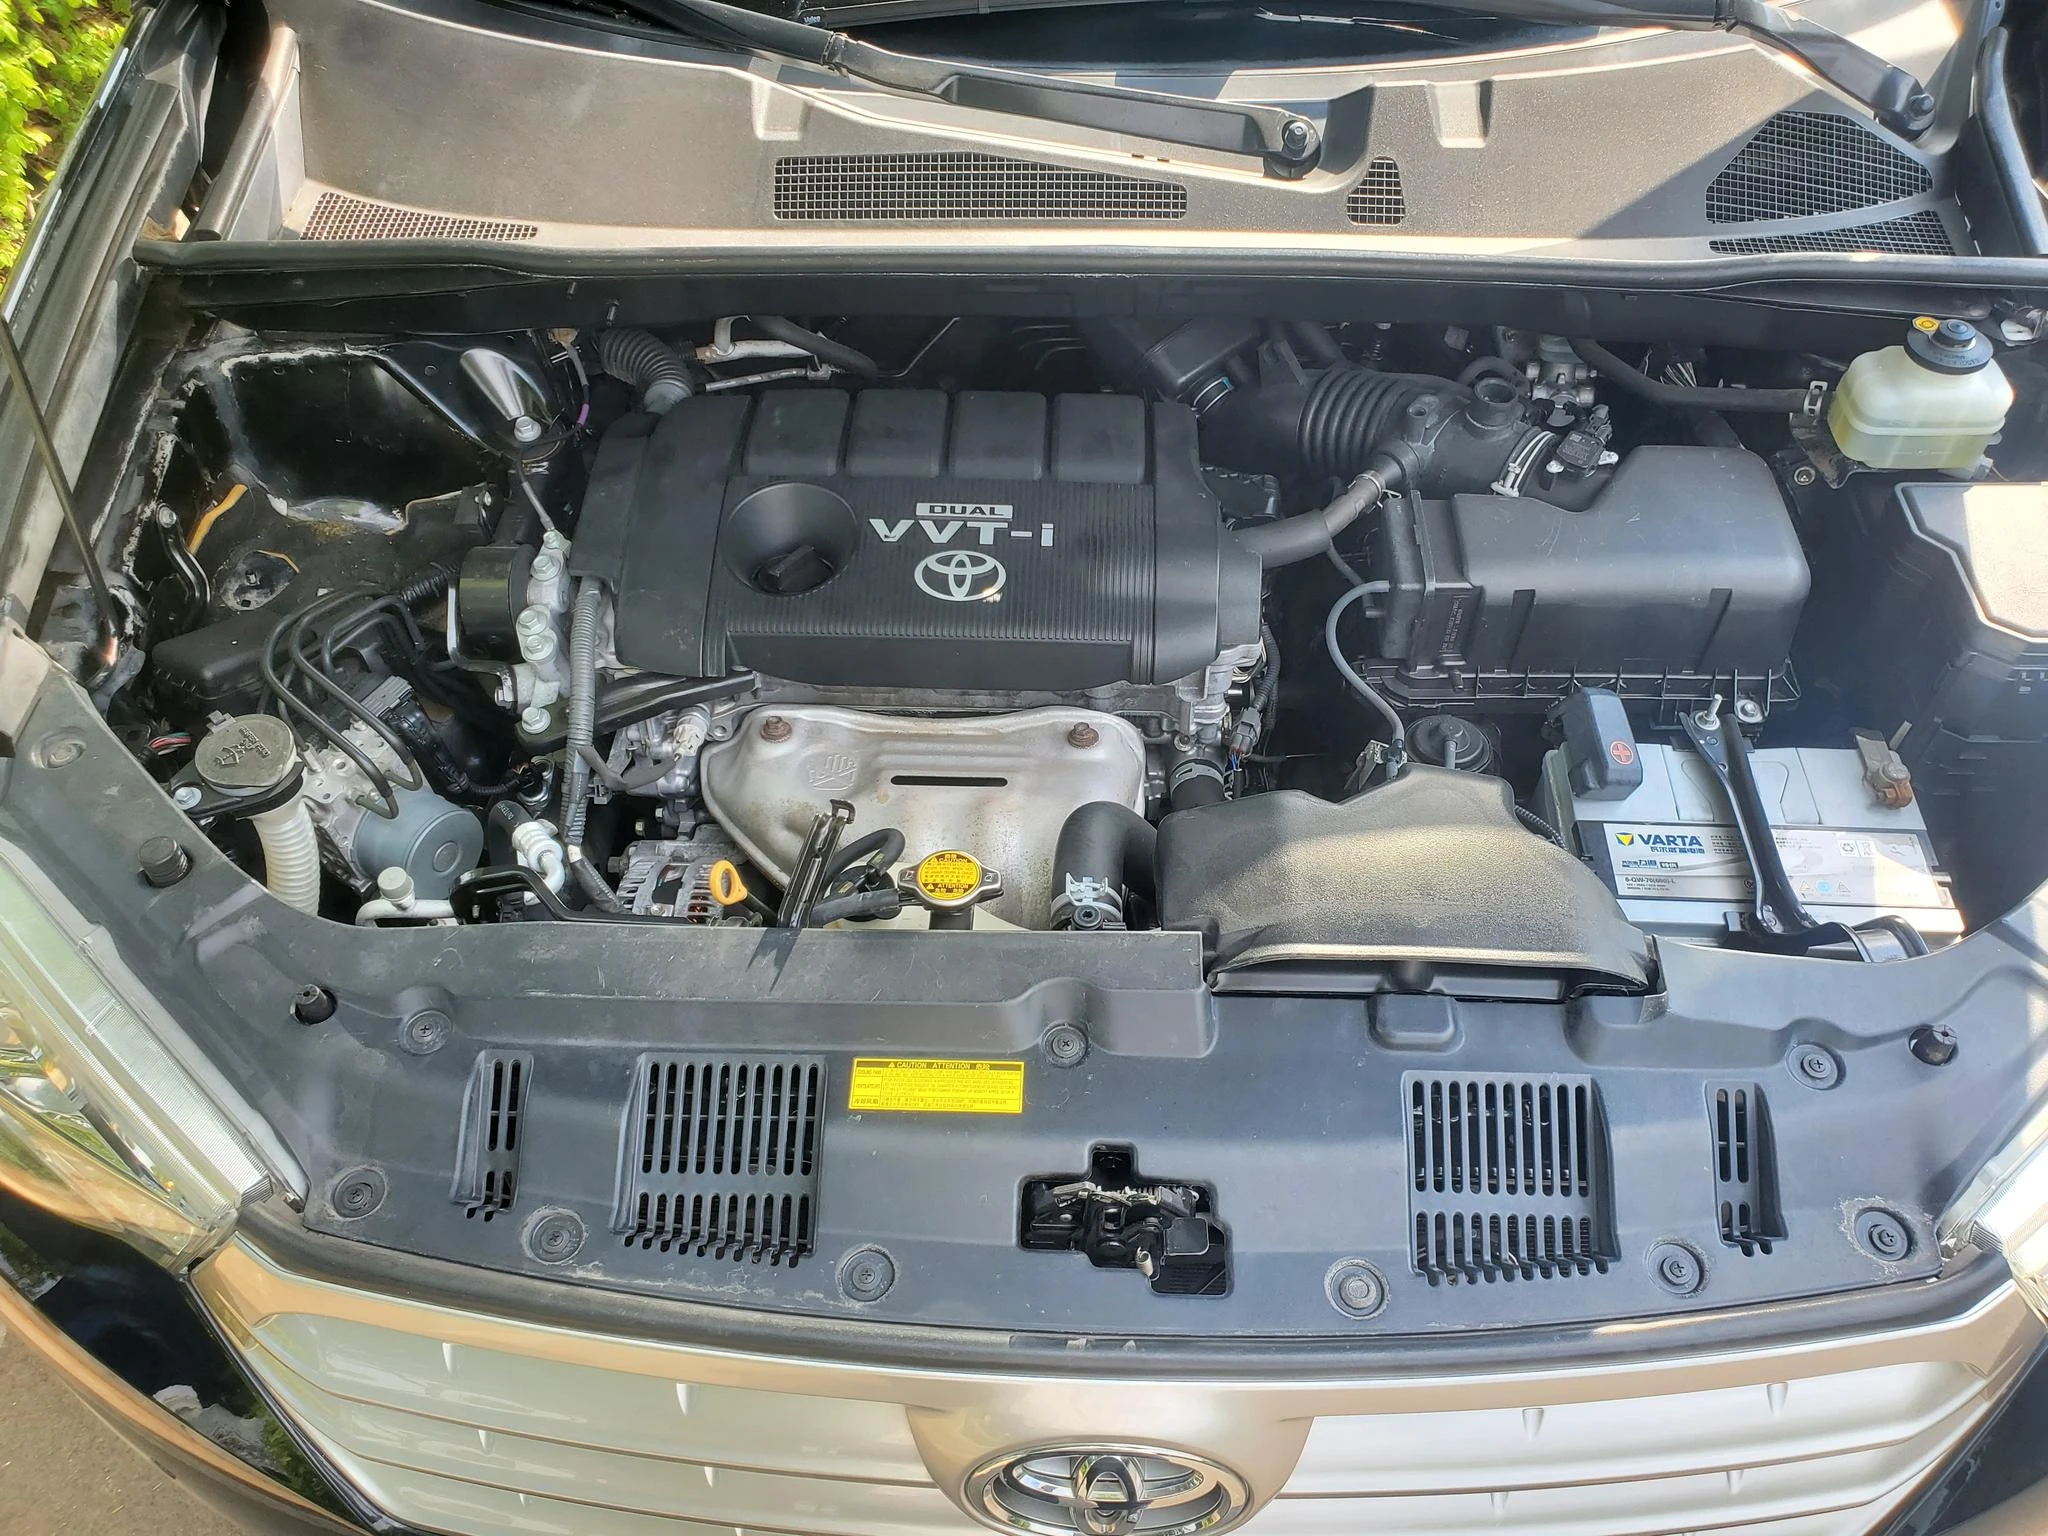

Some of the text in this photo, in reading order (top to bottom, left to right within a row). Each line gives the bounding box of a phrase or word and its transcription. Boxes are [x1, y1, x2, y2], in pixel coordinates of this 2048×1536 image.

[929, 505, 1004, 515] DUAL
[869, 518, 1054, 547] VVT-i
[1637, 834, 1703, 847] VARTA
[933, 1062, 970, 1070] ATTENTION
